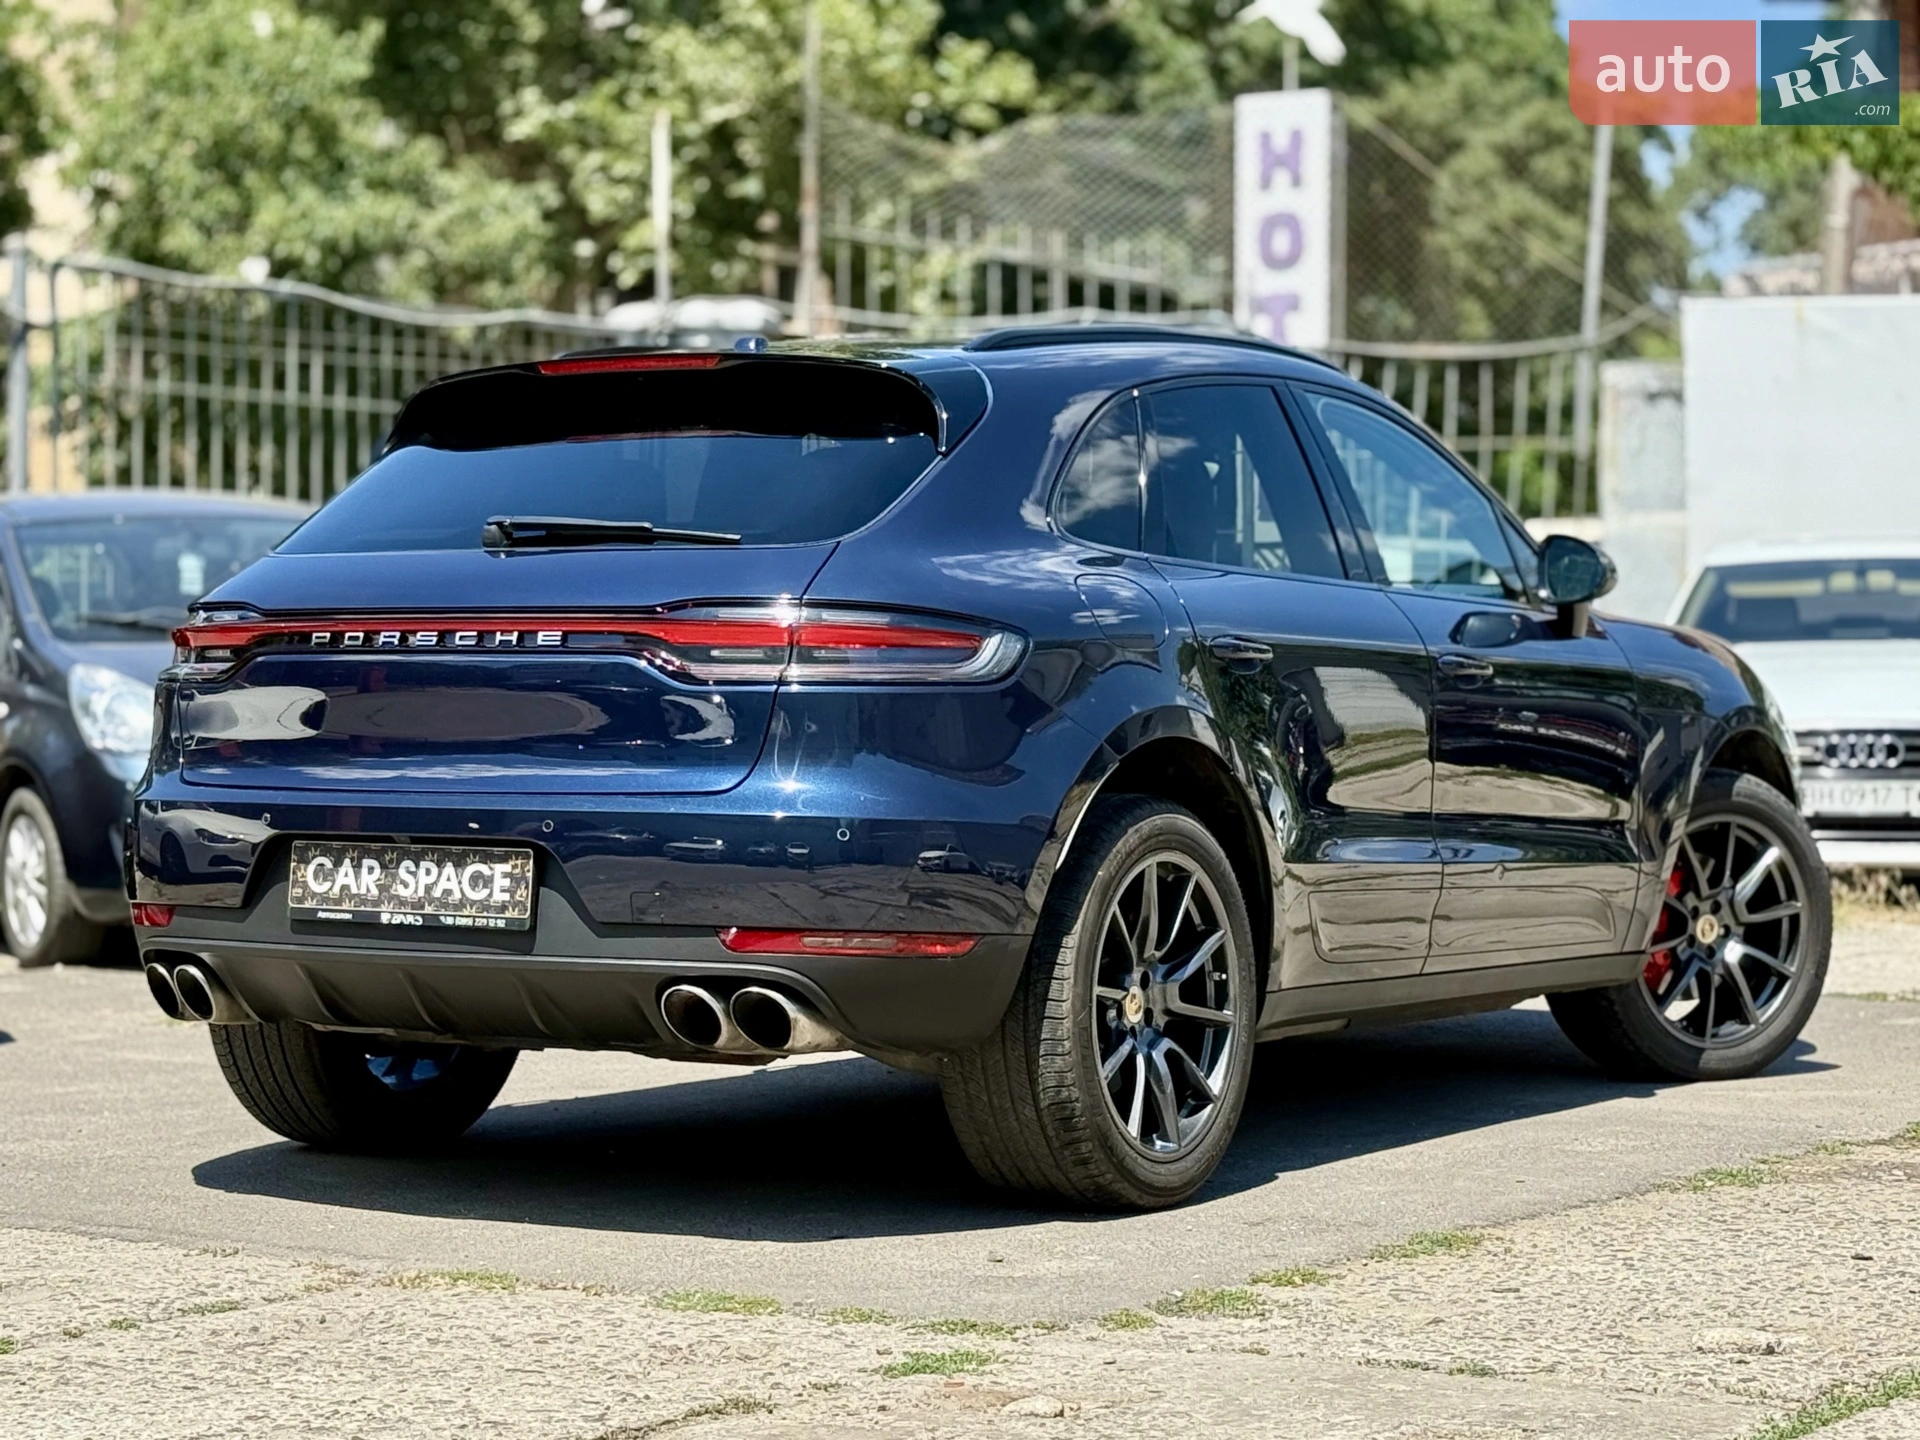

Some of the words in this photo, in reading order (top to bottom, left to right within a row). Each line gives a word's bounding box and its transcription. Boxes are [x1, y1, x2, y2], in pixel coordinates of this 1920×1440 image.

[311, 631, 563, 647] PORSCHE
[306, 856, 382, 896] CAR
[397, 859, 512, 902] SPACE
